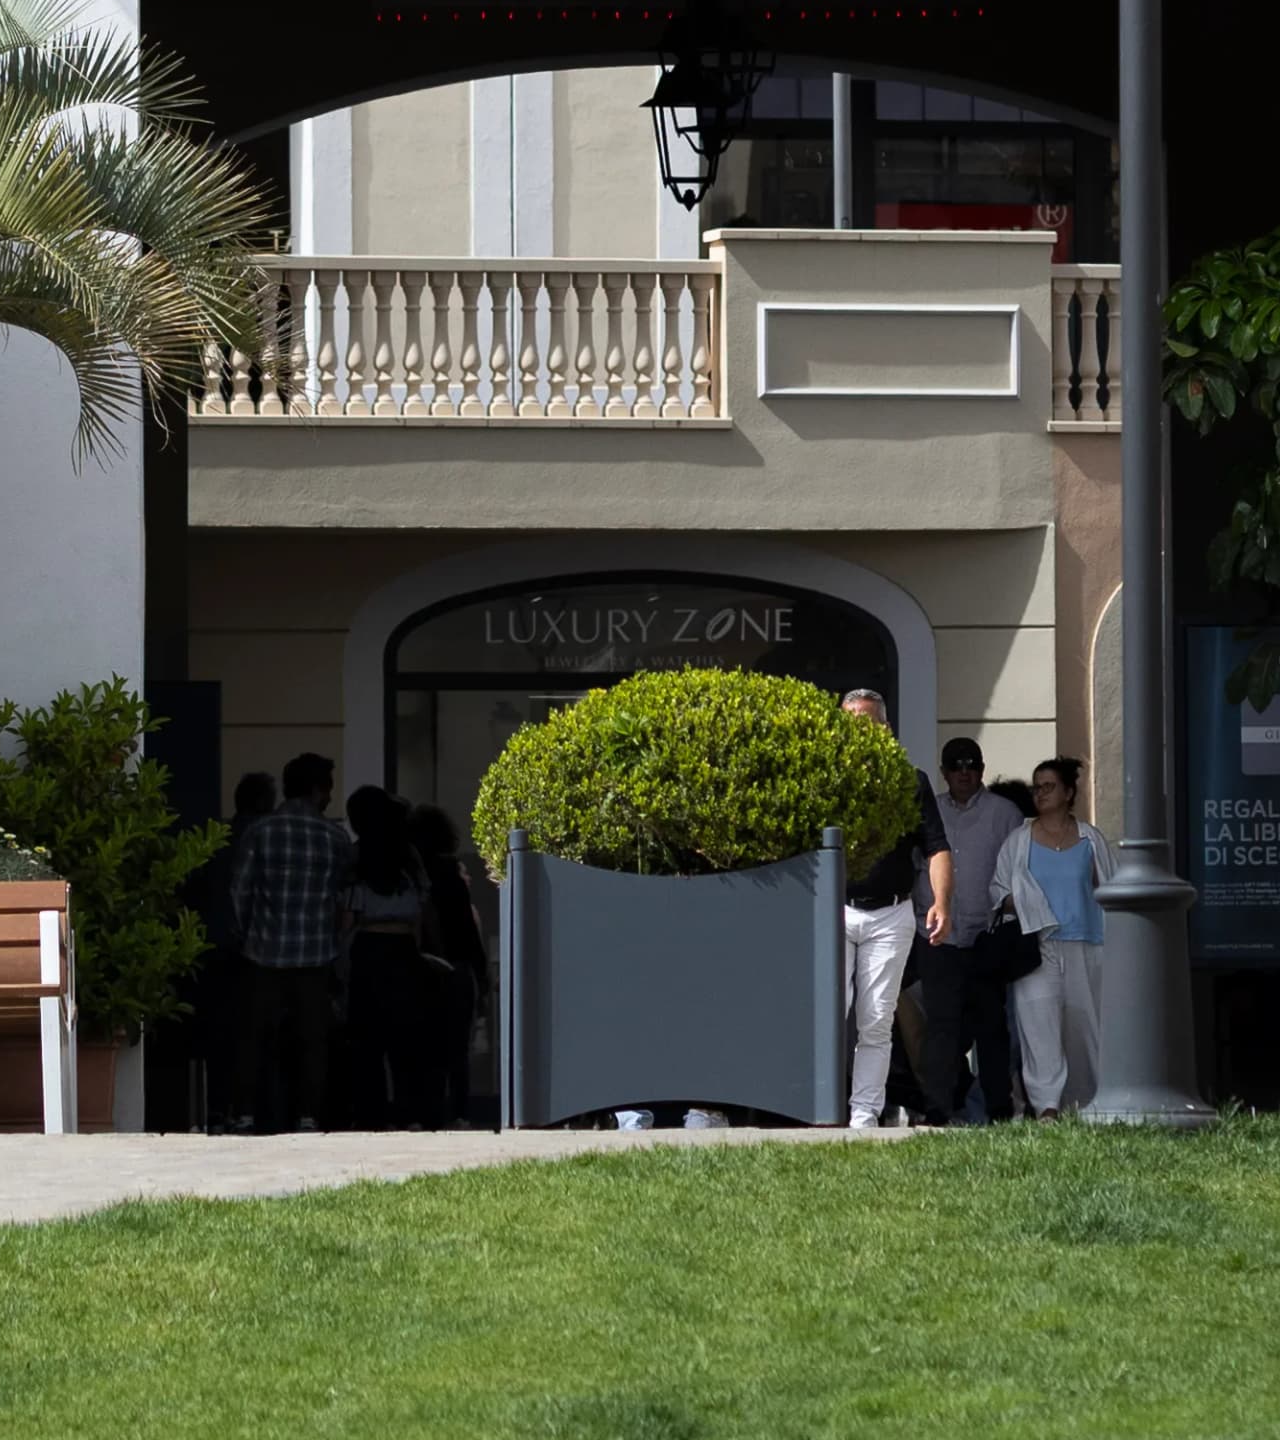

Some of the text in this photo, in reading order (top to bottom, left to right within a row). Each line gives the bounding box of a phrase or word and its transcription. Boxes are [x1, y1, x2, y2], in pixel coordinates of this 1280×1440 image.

[484, 607, 794, 644] LUXURY ZONE
[1203, 823, 1234, 842] LA
[1203, 846, 1227, 866] DI
